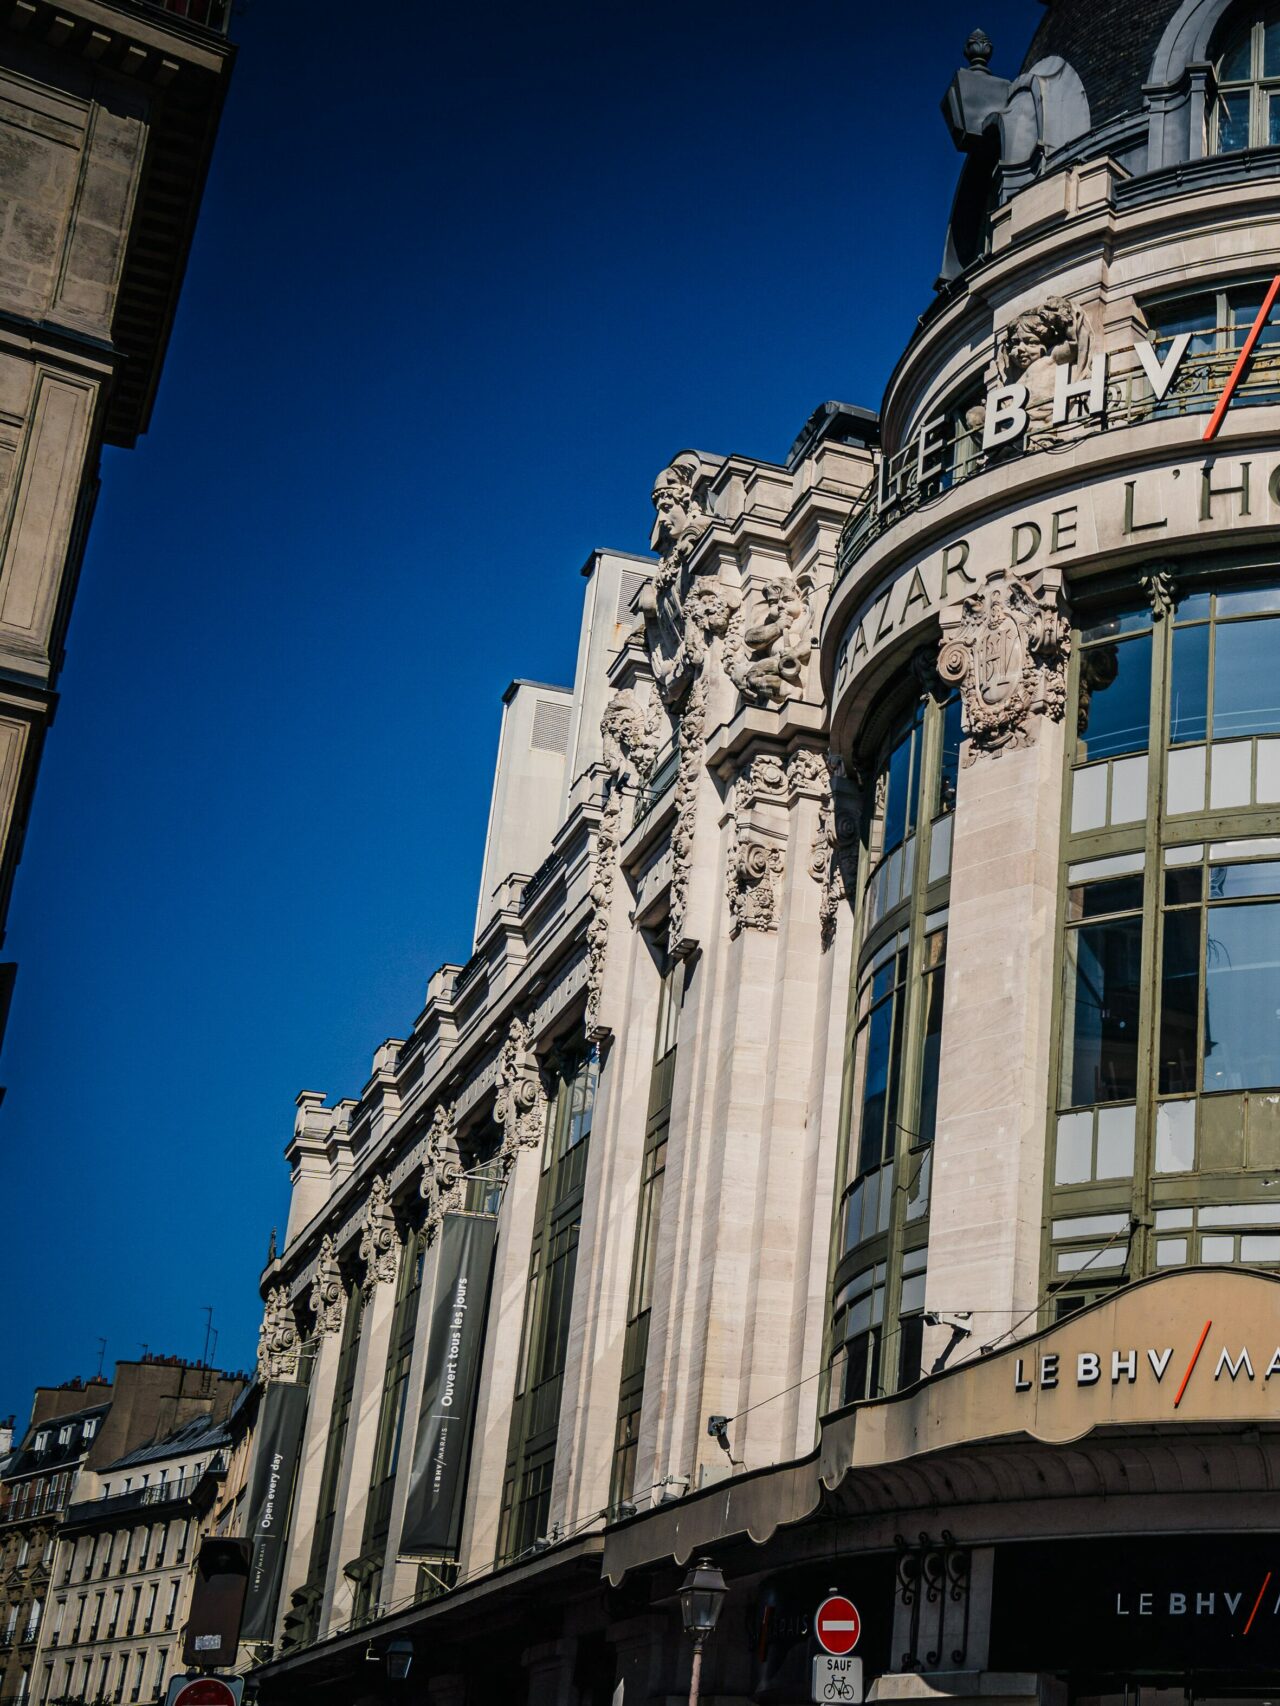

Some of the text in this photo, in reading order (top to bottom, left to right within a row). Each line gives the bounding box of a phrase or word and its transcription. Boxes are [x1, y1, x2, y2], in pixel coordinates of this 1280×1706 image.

[878, 413, 946, 514] LE
[1011, 505, 1080, 568] DE
[441, 1278, 468, 1407] Ouvert tous les jours
[1014, 1355, 1060, 1392] LE
[261, 1453, 284, 1528] Open every day
[1116, 1592, 1153, 1616] LE
[826, 1658, 852, 1672] SAUF
